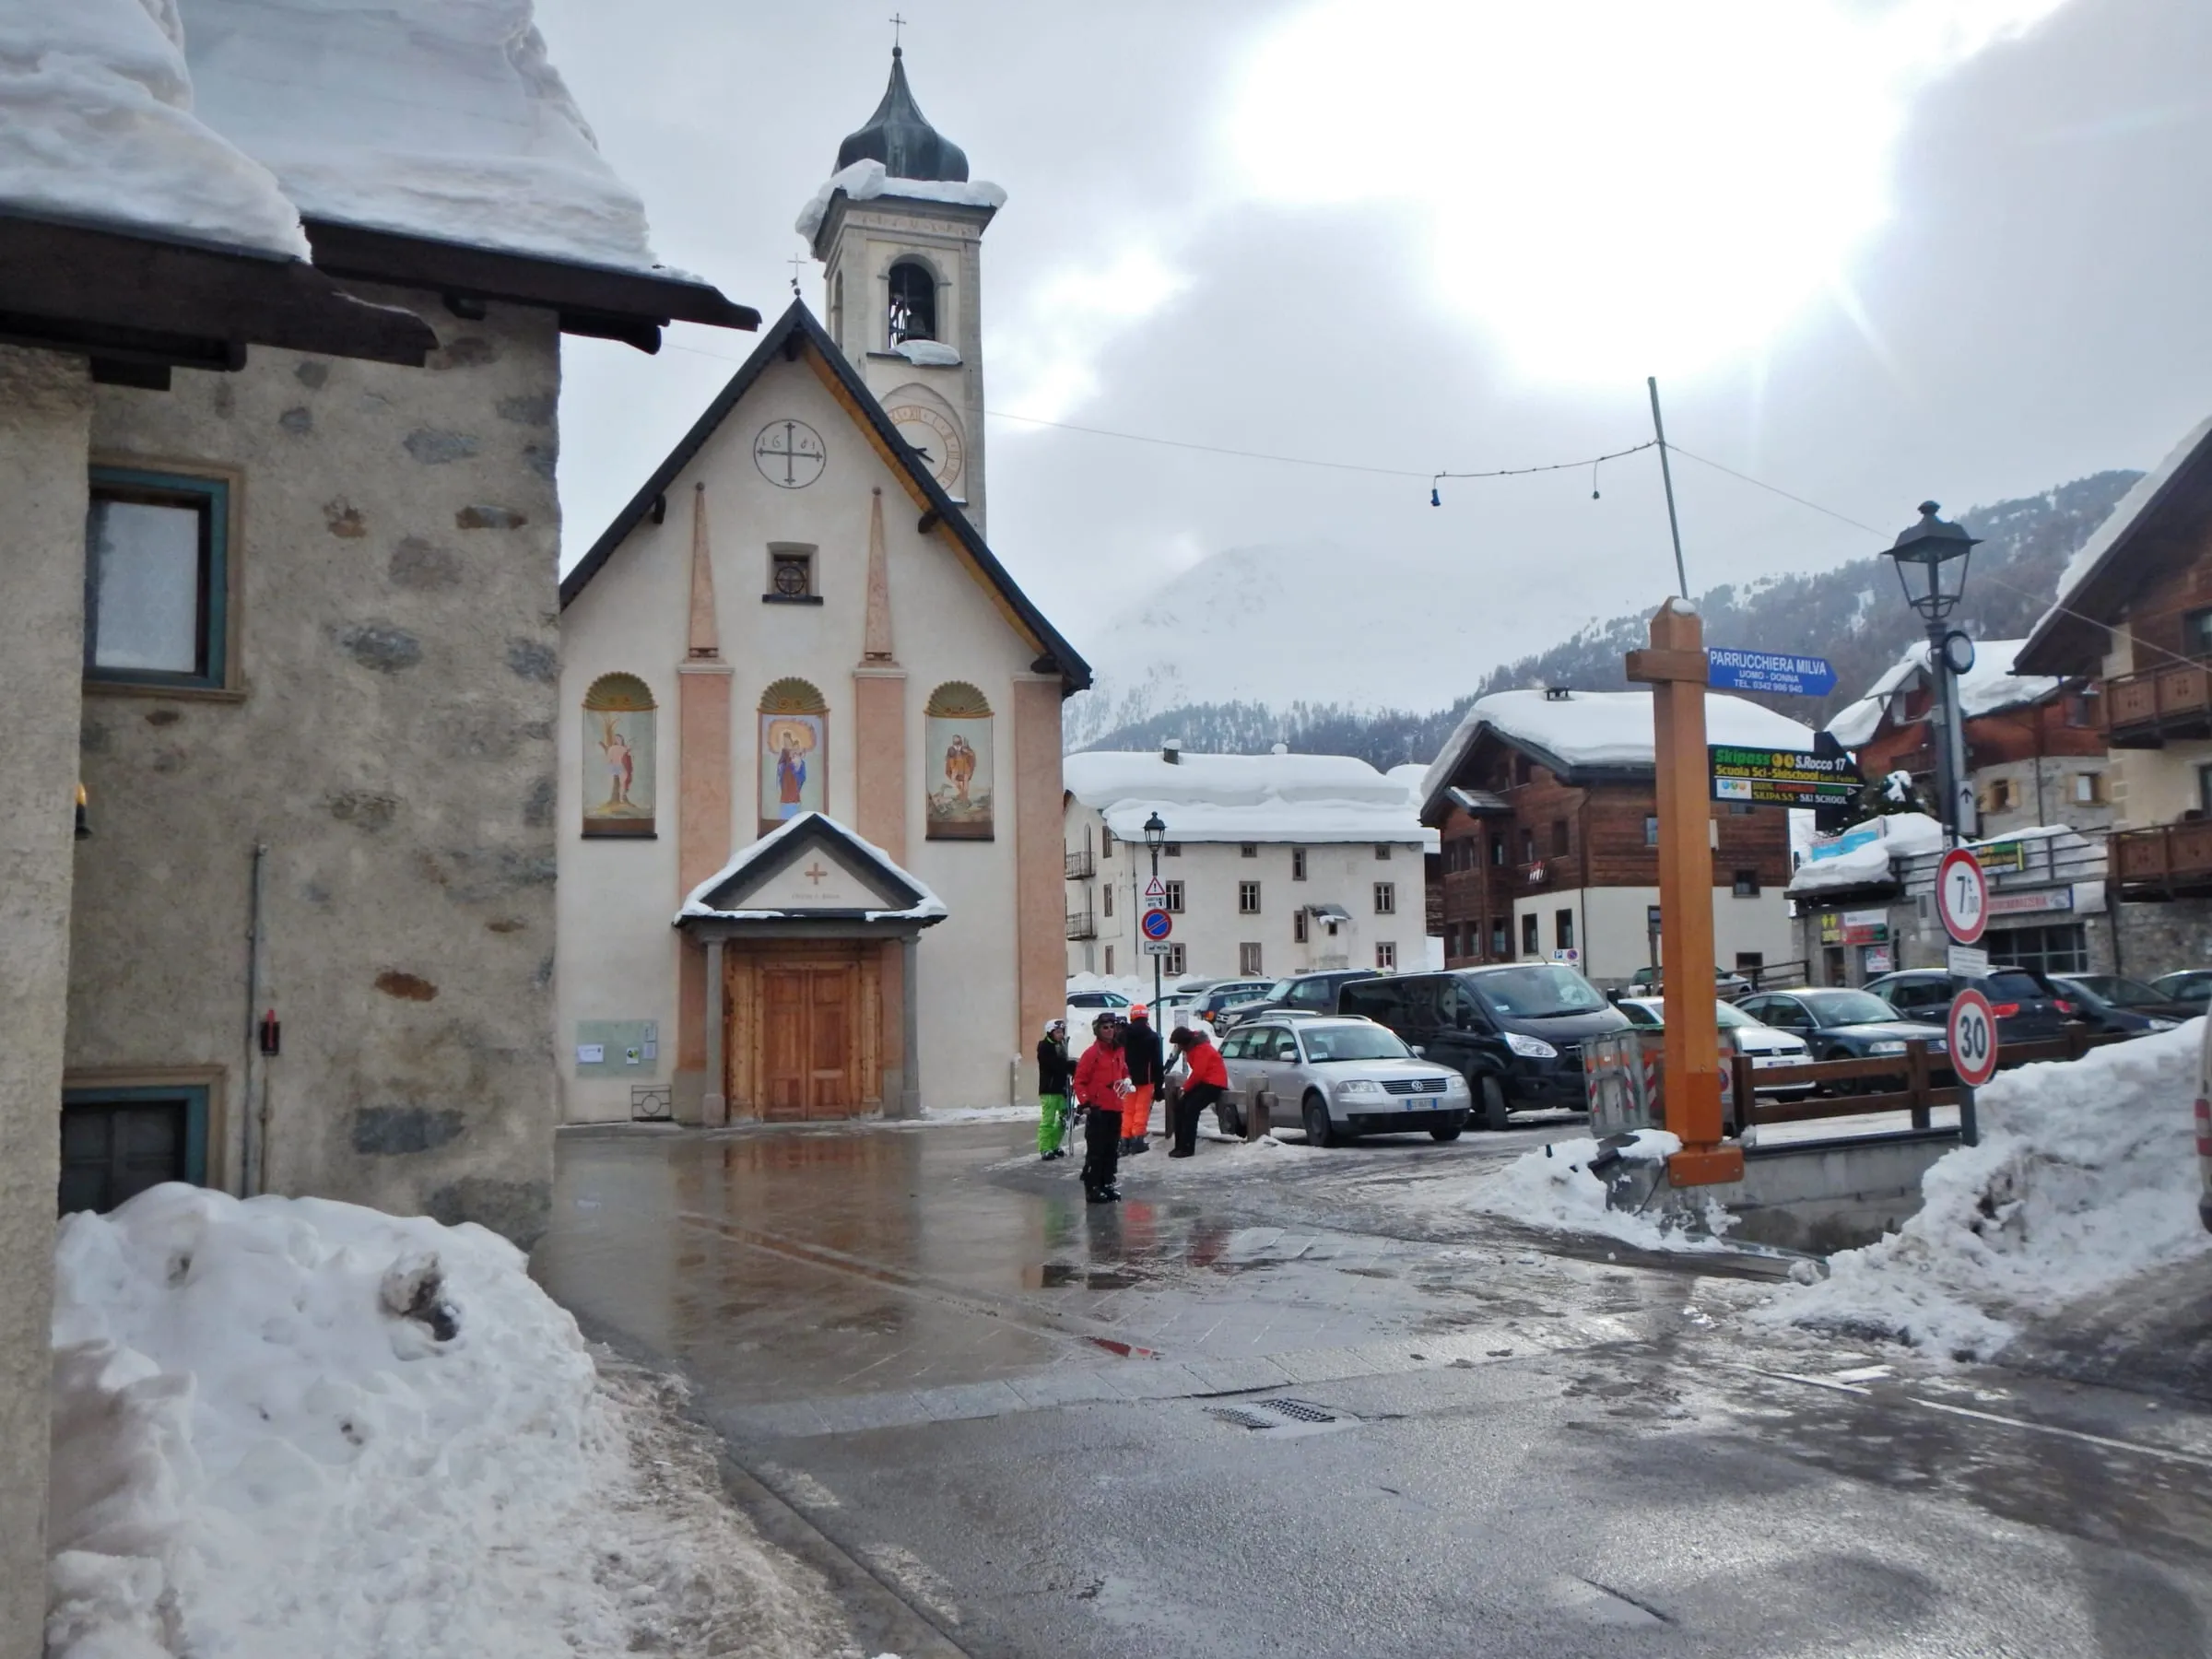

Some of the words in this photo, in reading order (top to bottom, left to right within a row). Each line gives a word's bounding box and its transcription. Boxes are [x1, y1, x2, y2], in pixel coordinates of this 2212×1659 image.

[1710, 651, 1794, 672] PARRUCCHIERA
[1796, 659, 1827, 676] MILVA
[1739, 670, 1764, 680] UOMO
[1770, 673, 1799, 683] DONNA
[1715, 749, 1771, 766] Skipass
[1835, 758, 1846, 771] 17
[1715, 764, 1750, 776] Scuola
[1753, 791, 1794, 802] SKIPASS
[1800, 794, 1813, 803] SKI
[1815, 794, 1848, 805] SCHOOL
[1959, 1016, 1986, 1060] 30
